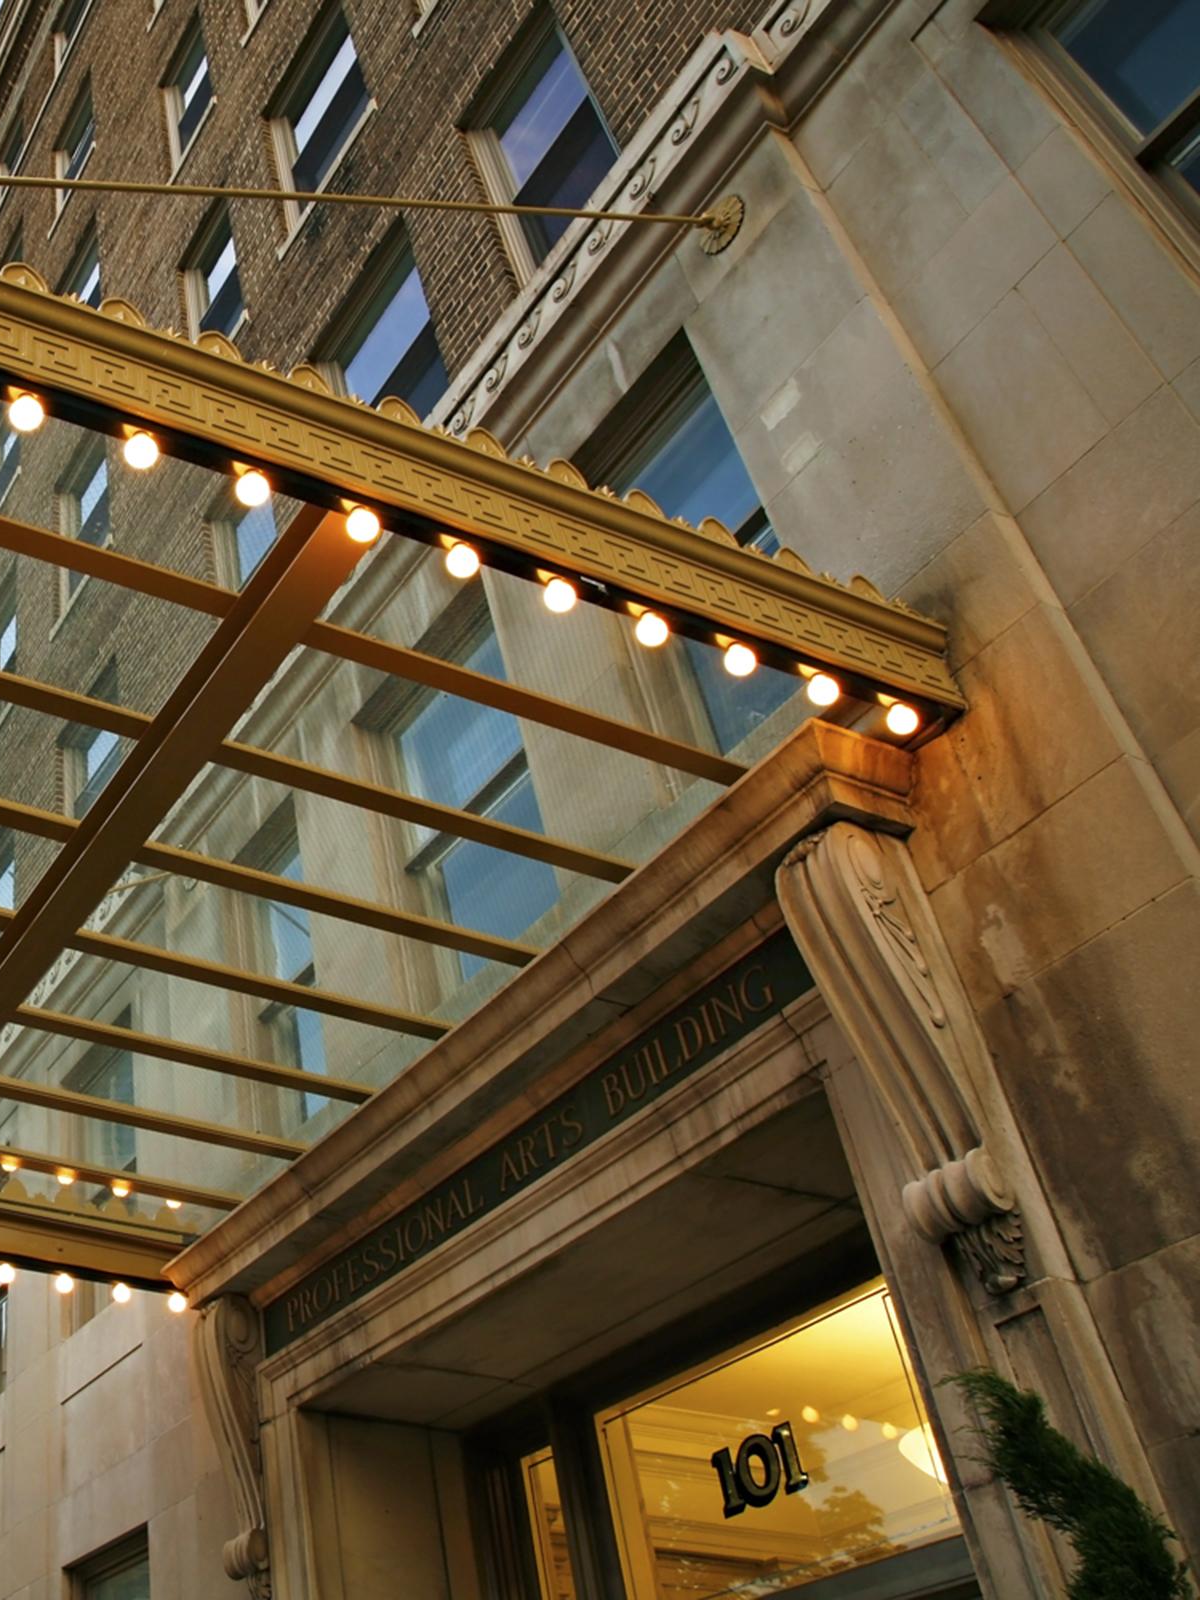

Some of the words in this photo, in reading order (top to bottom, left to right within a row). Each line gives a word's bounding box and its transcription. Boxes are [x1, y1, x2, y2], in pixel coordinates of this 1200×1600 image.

[286, 1179, 485, 1332] PROFESSIONAL
[499, 1105, 584, 1192] ARTS
[602, 965, 775, 1117] BUILDING
[711, 1421, 809, 1519] 101
